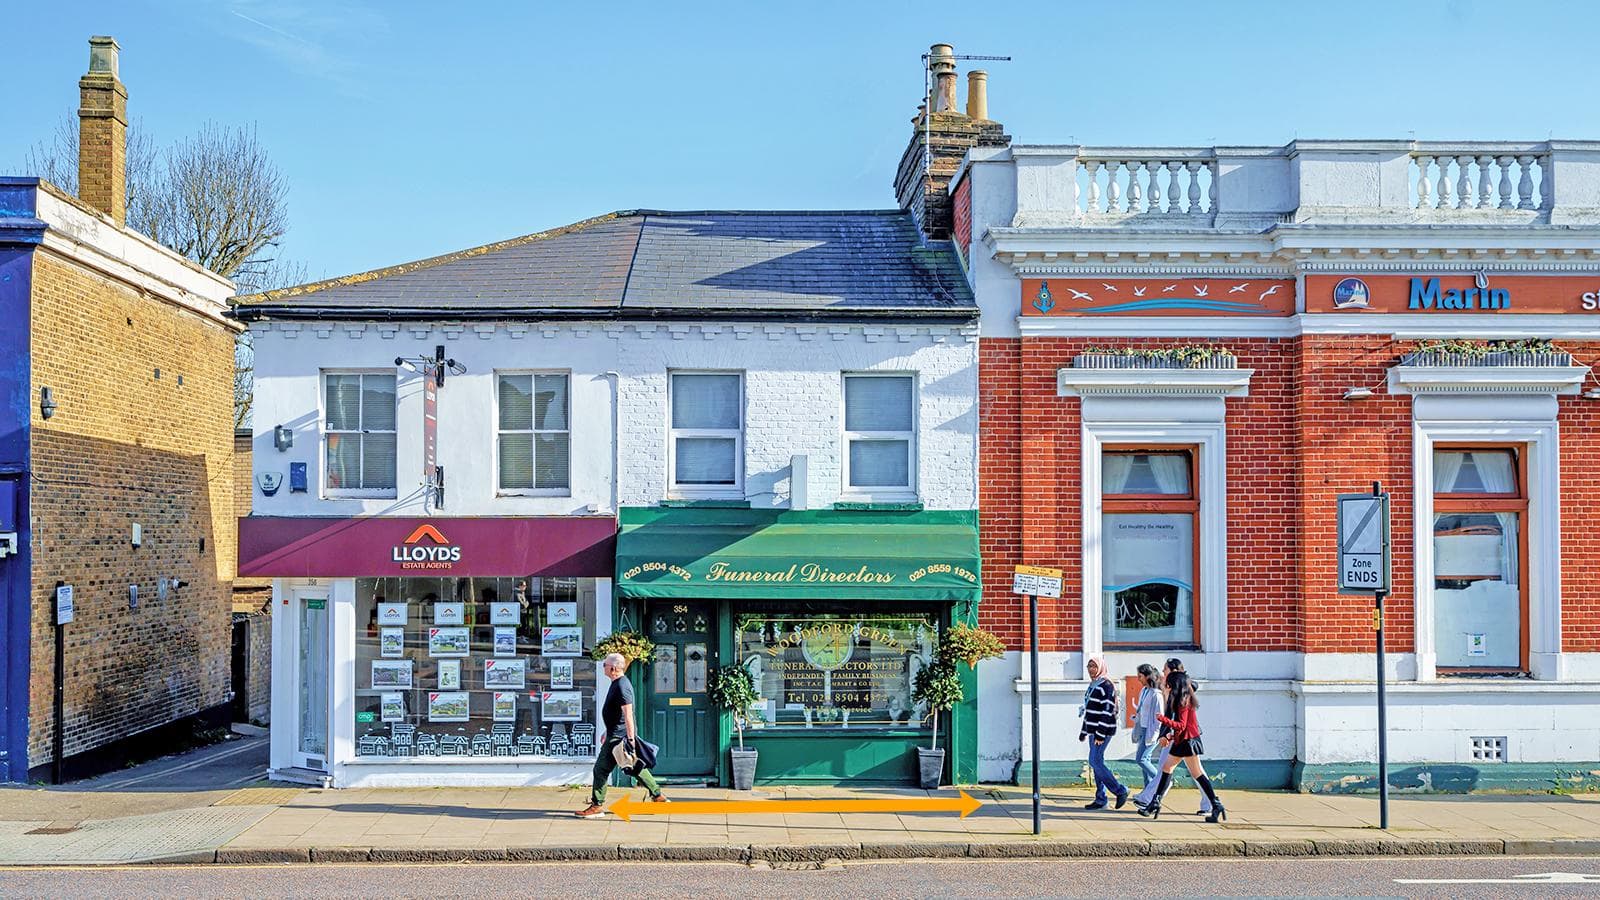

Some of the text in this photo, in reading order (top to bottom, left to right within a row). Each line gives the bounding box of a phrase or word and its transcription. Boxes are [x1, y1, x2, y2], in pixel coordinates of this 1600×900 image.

[1408, 276, 1511, 309] Marin
[392, 546, 461, 562] LLOYDS
[1352, 558, 1372, 568] Zone
[623, 562, 692, 582] 020 8504 4372
[705, 561, 896, 583] Funeral Directors
[908, 568, 926, 583] 020
[927, 563, 952, 573] 8559
[1347, 571, 1378, 583] ENDS
[673, 605, 689, 614] 354
[788, 692, 809, 702] Tel.
[834, 692, 860, 702] 8504
[863, 692, 888, 702] 4372
